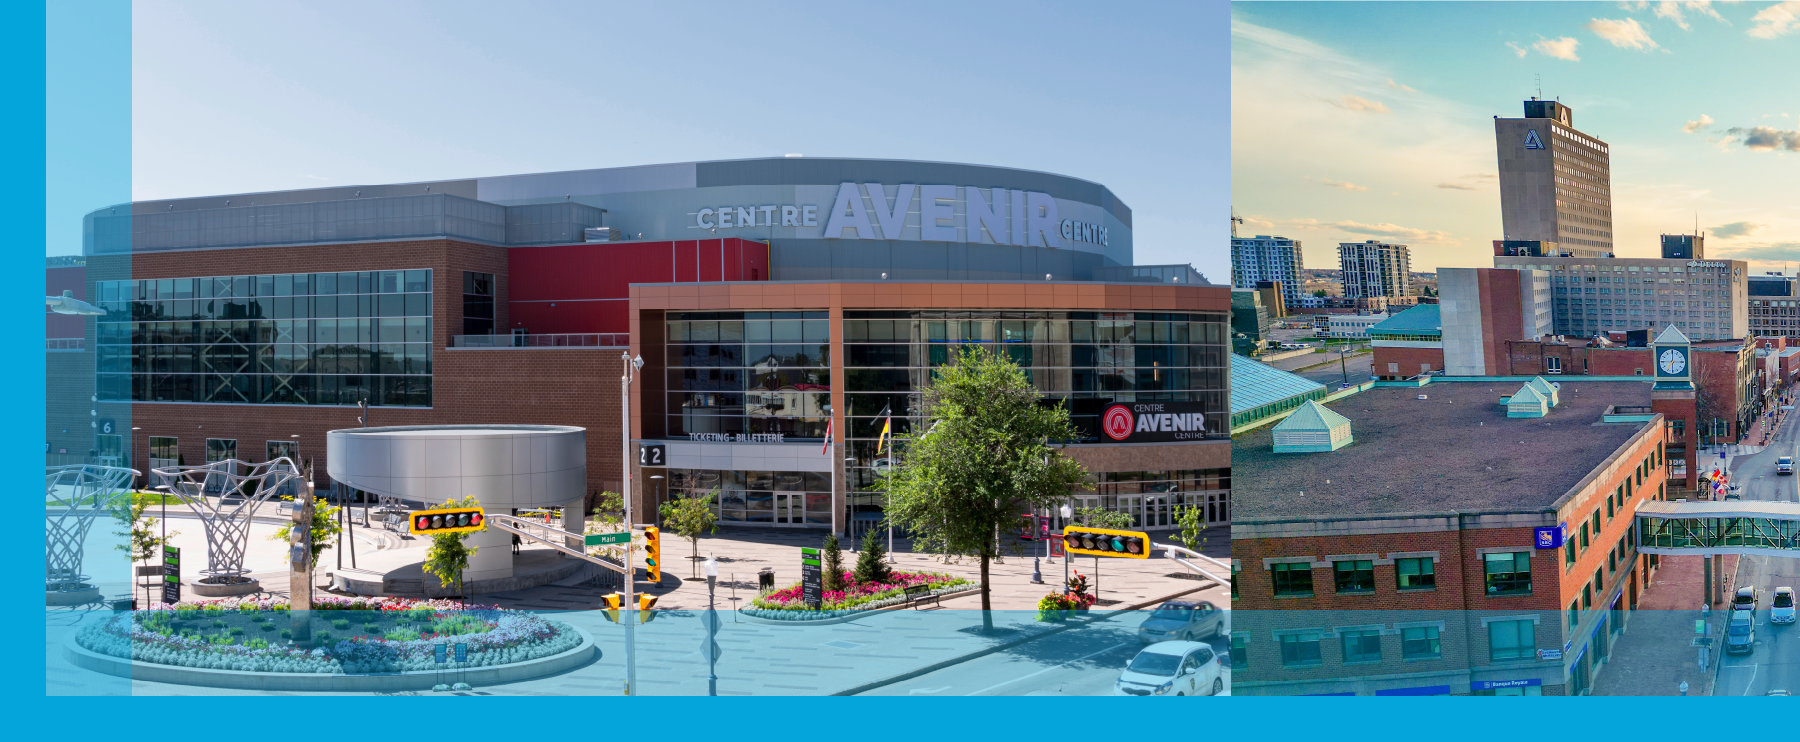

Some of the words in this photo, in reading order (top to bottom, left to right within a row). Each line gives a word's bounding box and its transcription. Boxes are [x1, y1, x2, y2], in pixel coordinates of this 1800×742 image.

[696, 204, 819, 230] CENTRE
[822, 181, 1062, 249] AVENIR
[1060, 218, 1109, 248] CENTRE
[1134, 404, 1164, 412] CENTRE
[103, 421, 112, 434] 6
[1135, 413, 1205, 432] AVENIR
[689, 432, 730, 442] TICKETING
[736, 433, 784, 443] BILLETTERIE
[1174, 432, 1205, 440] CENTRE
[640, 448, 646, 463] 2
[652, 448, 661, 464] 2
[601, 535, 616, 543] Main
